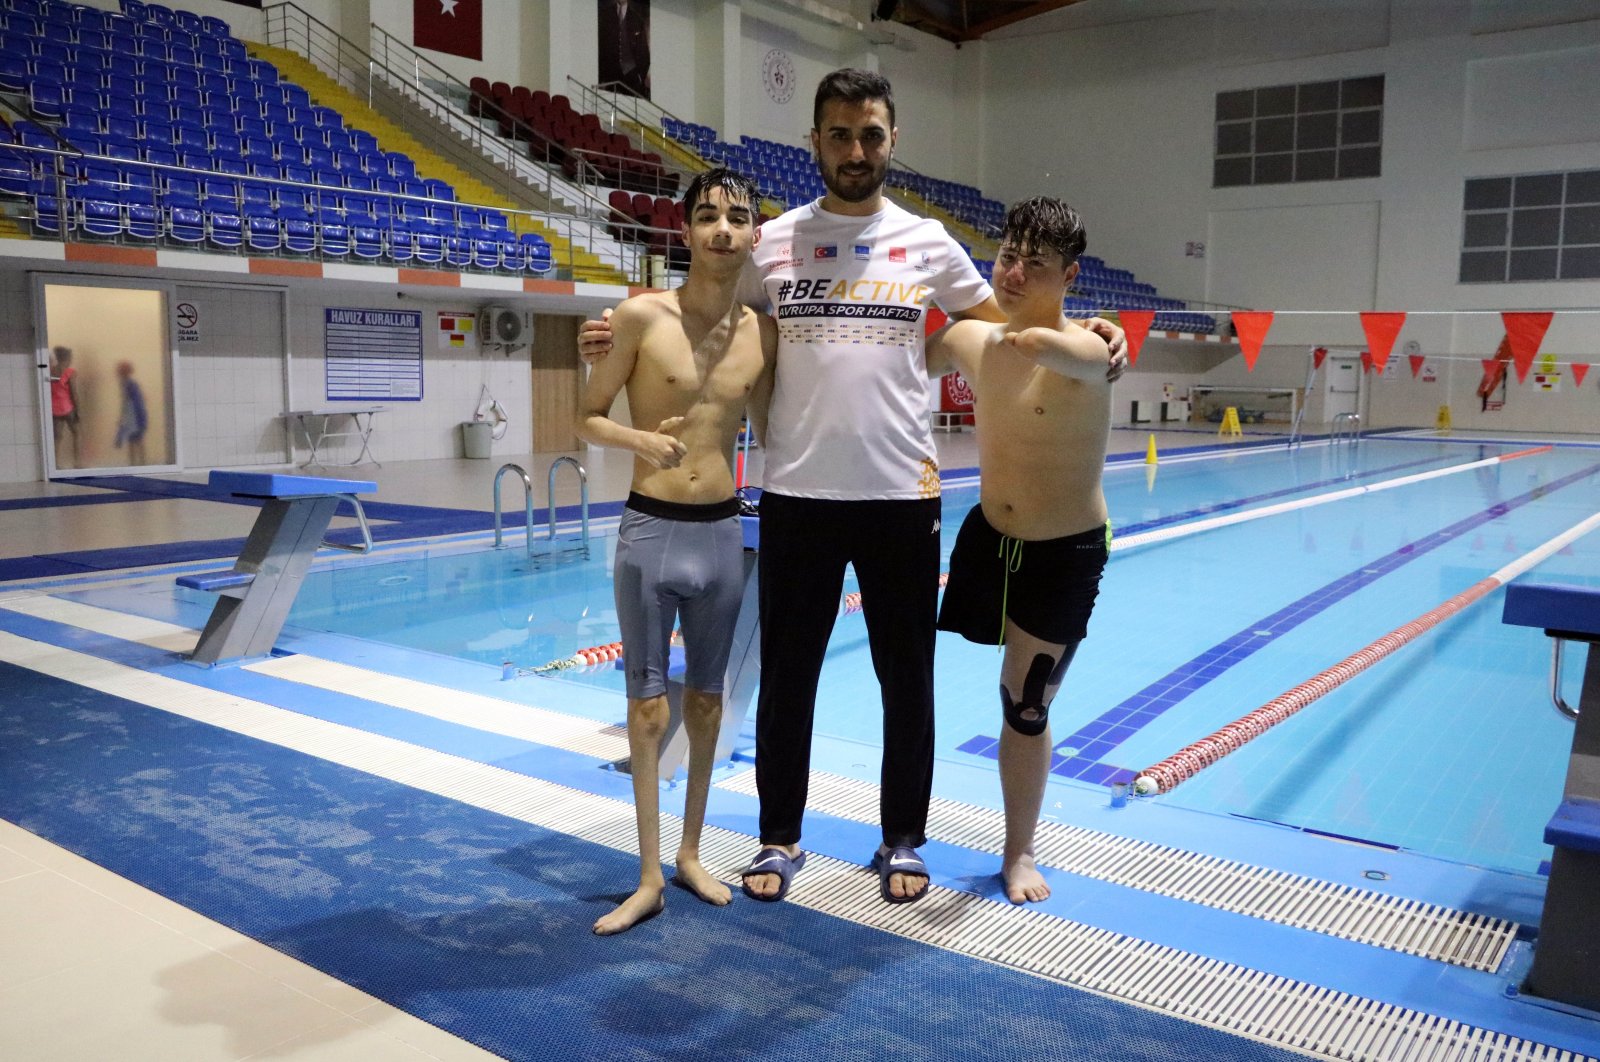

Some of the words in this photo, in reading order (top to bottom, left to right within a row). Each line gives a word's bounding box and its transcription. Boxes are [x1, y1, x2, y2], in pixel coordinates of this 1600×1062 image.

[778, 278, 928, 305] #BEACTIVE
[331, 310, 363, 324] HAVUZ
[365, 312, 416, 327] KURALLARI
[780, 305, 825, 316] AVRUPA
[827, 305, 865, 316] SPOR
[867, 307, 920, 320] HAFTASI
